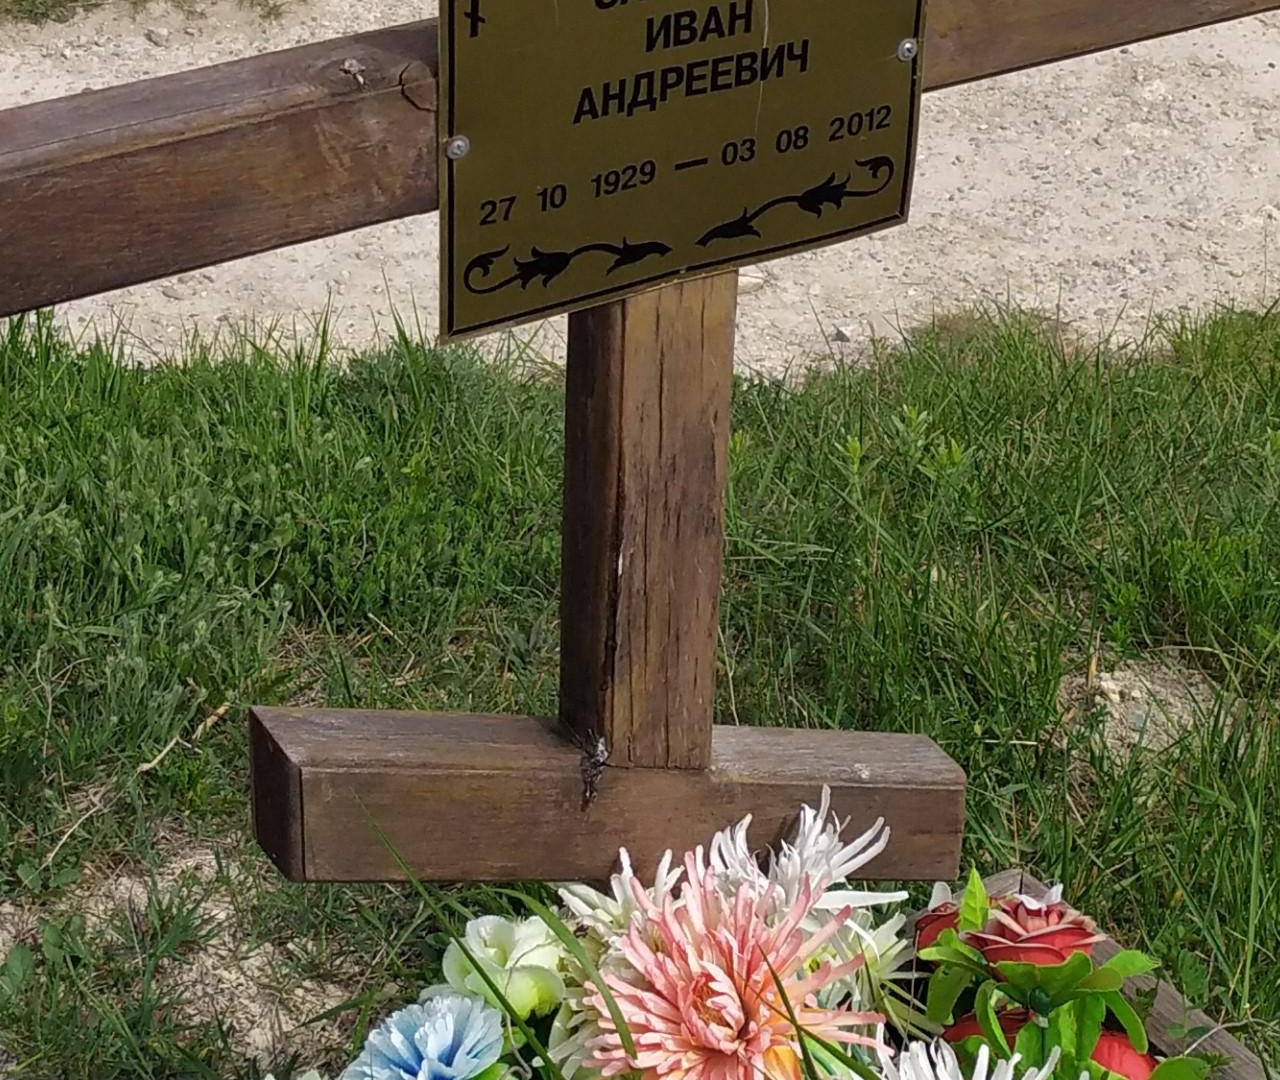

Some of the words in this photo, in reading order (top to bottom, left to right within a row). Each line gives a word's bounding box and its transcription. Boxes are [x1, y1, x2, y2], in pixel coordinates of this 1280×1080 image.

[645, 0, 753, 53] ИВАН
[573, 39, 810, 125] АНДРЕЕВИЧ
[479, 196, 517, 226] 27
[536, 184, 567, 212] 10
[591, 159, 656, 199] 1929
[721, 137, 756, 166] 03
[775, 125, 810, 154] 08
[828, 105, 892, 142] 2012
